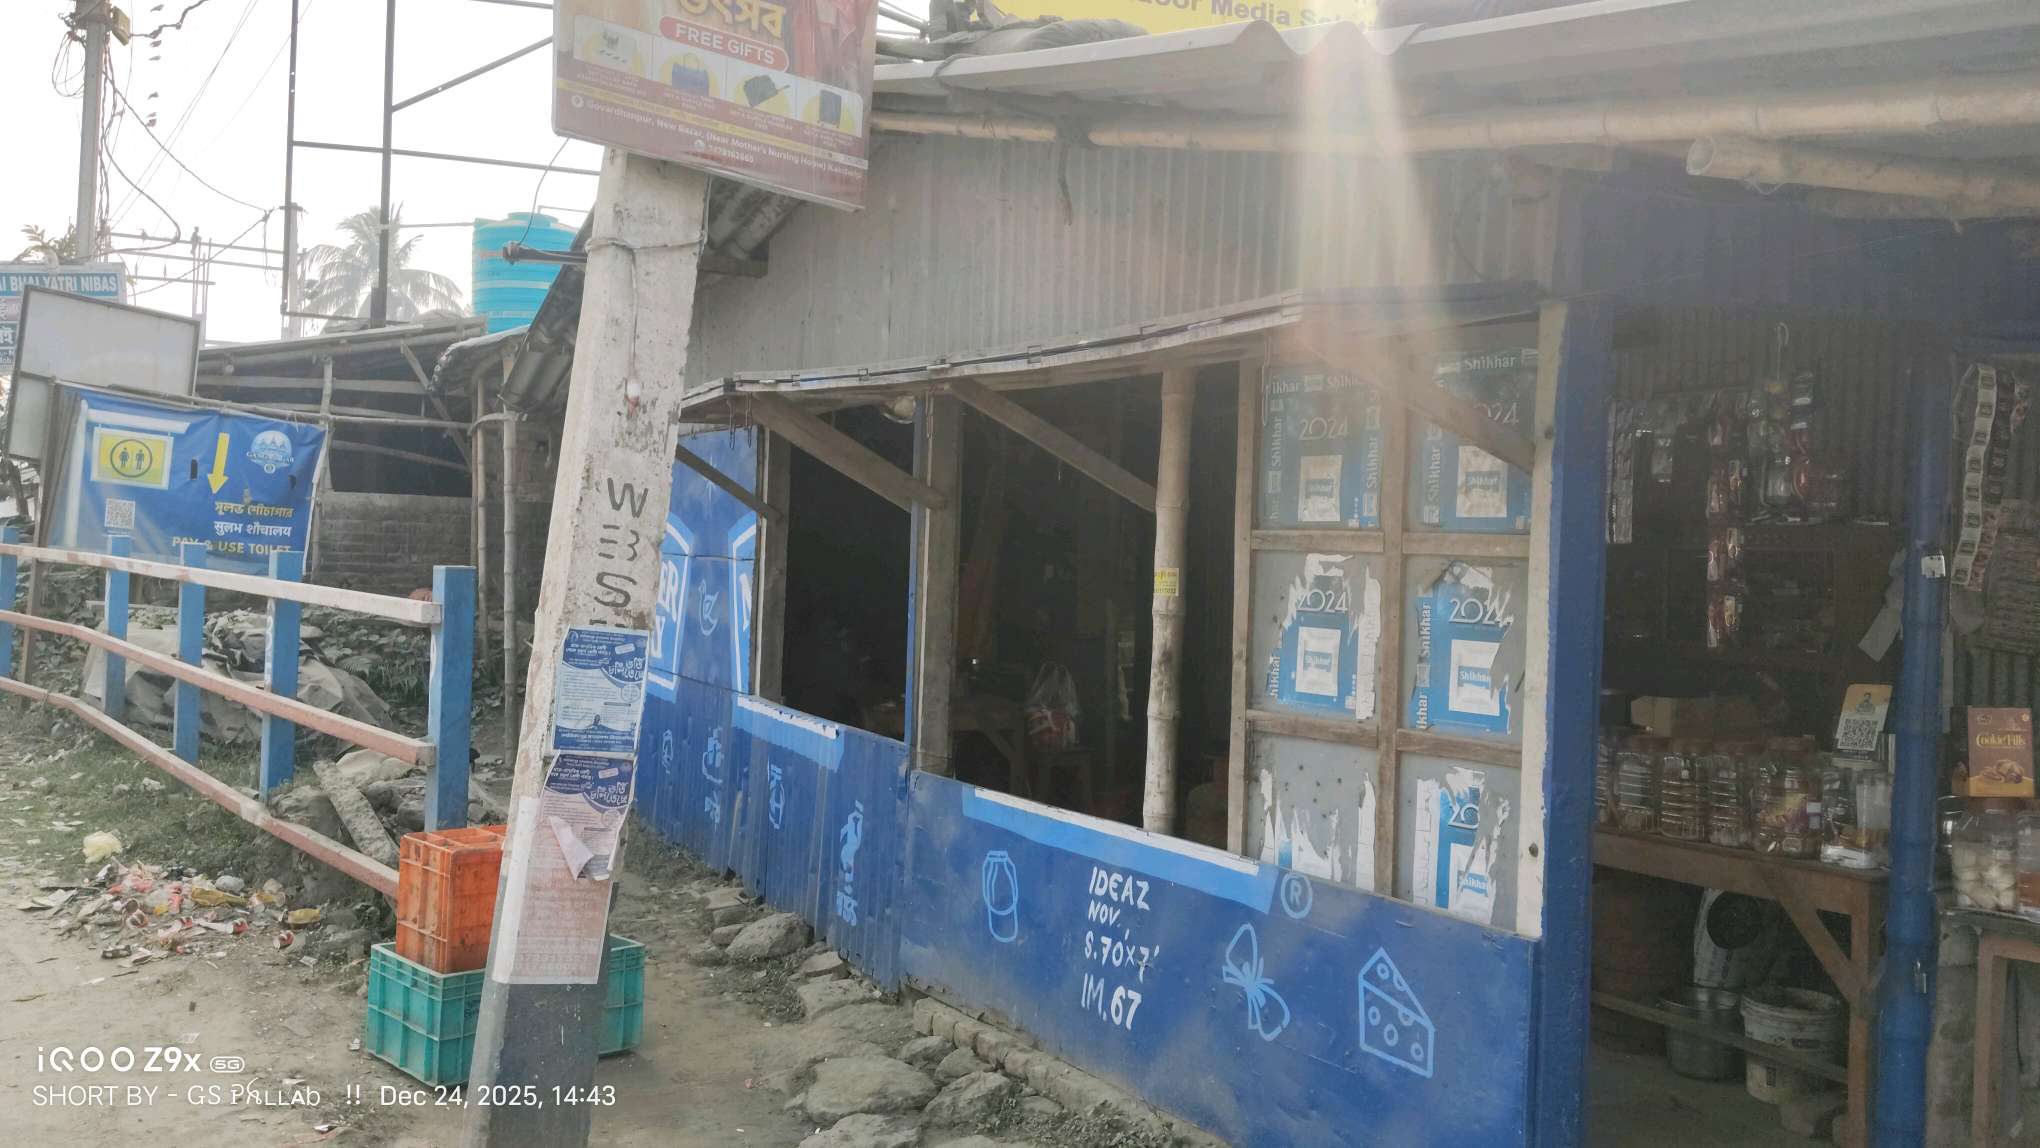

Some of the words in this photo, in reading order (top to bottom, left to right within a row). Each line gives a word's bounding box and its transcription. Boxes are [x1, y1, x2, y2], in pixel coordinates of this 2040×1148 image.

[1211, 0, 1290, 25] Media
[675, 23, 724, 50] FREE
[728, 39, 775, 64] GIFTS
[43, 276, 77, 292] YATRI
[80, 276, 116, 292] NIBAS
[1464, 355, 1517, 370] Shikhar
[1299, 417, 1349, 441] 2024
[214, 521, 243, 536] सुलभ
[218, 541, 244, 554] USE
[1088, 866, 1150, 911] IDEAZ
